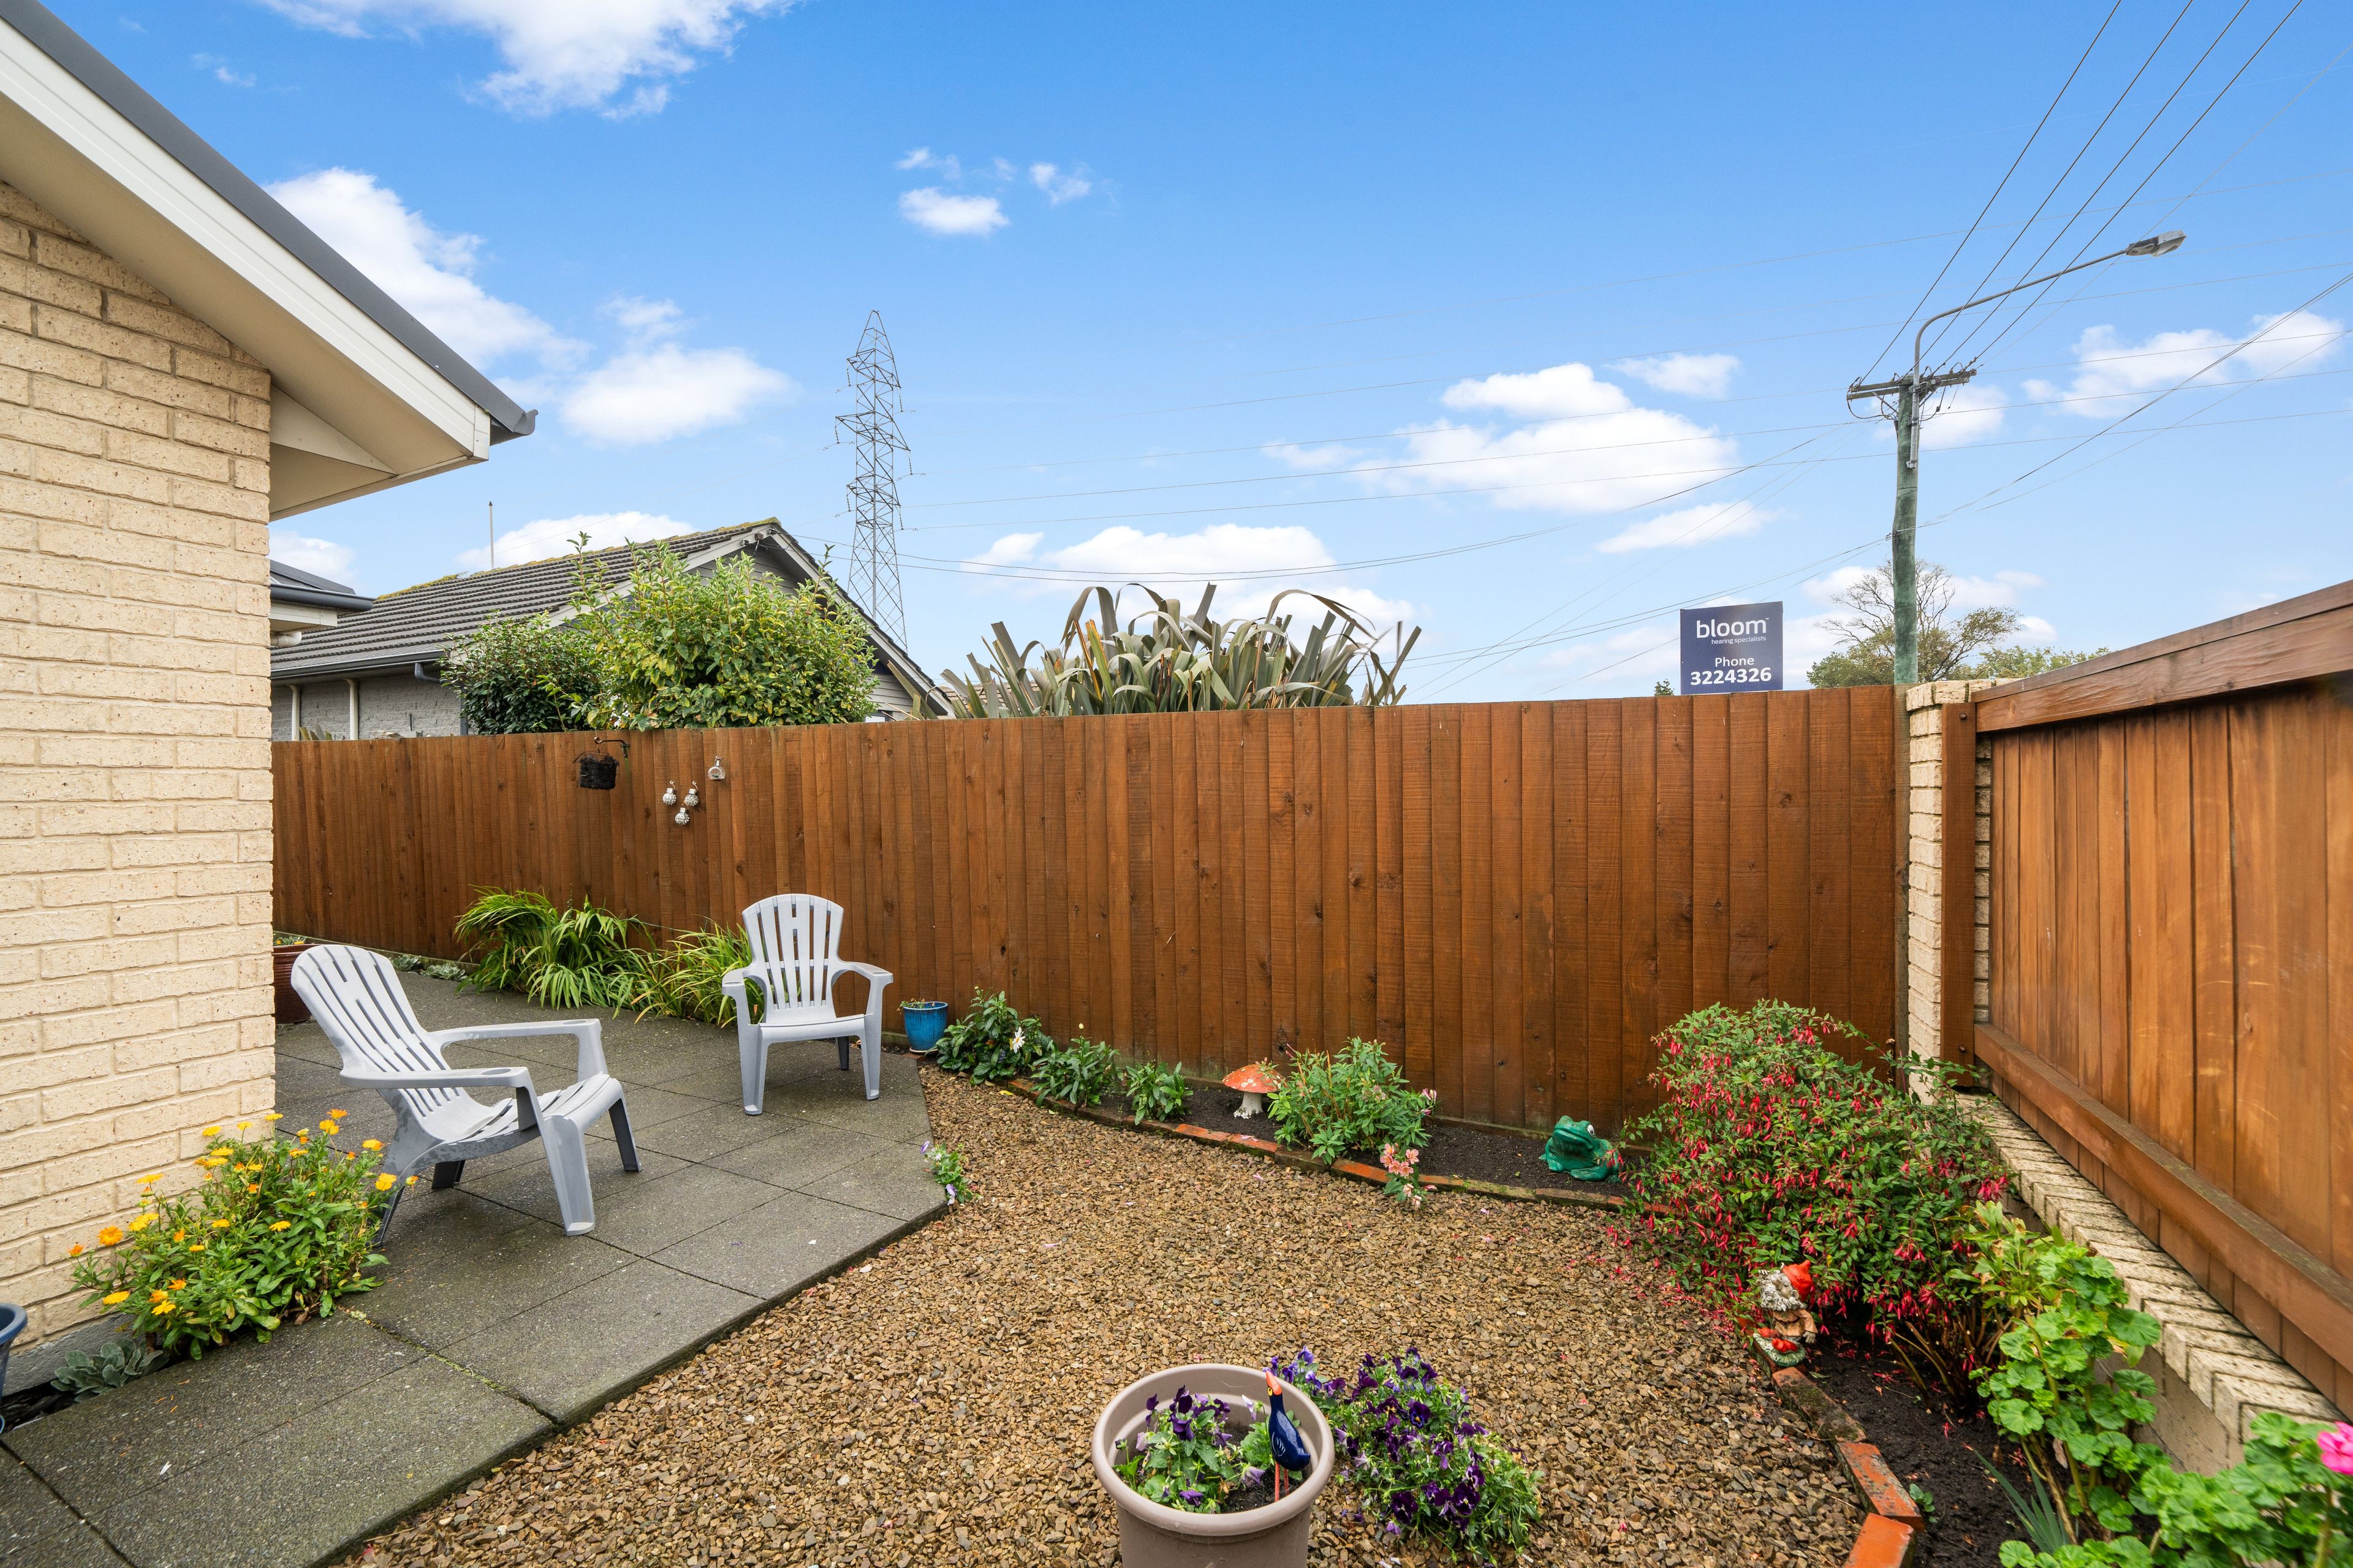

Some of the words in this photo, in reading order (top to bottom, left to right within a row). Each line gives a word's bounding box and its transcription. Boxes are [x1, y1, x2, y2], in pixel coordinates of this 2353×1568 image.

[1696, 618, 1767, 638] bloom
[1734, 635, 1767, 644] specialists
[1715, 657, 1754, 667] Phone
[1691, 667, 1772, 686] 3224326
